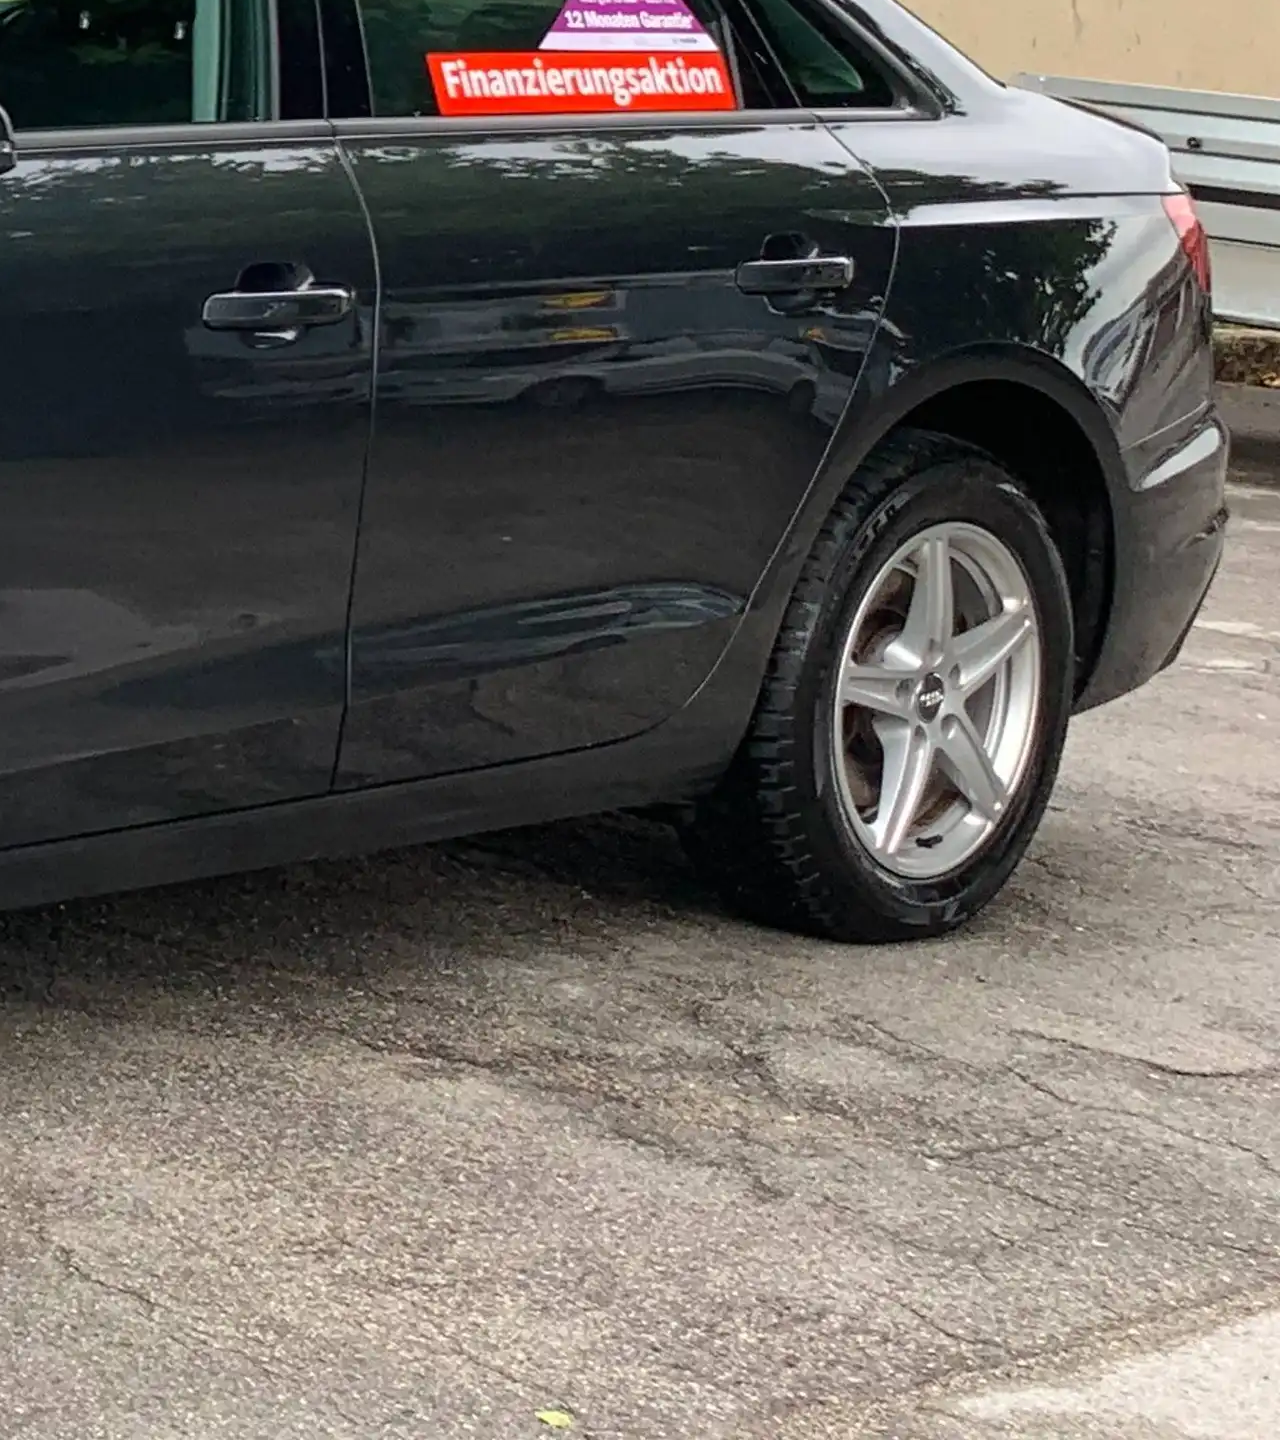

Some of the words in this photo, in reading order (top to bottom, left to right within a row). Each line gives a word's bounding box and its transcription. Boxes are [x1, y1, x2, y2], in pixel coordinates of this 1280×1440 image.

[564, 11, 585, 28] 12
[584, 10, 640, 28] Monaten
[441, 56, 724, 106] Finanzierungsaktion
